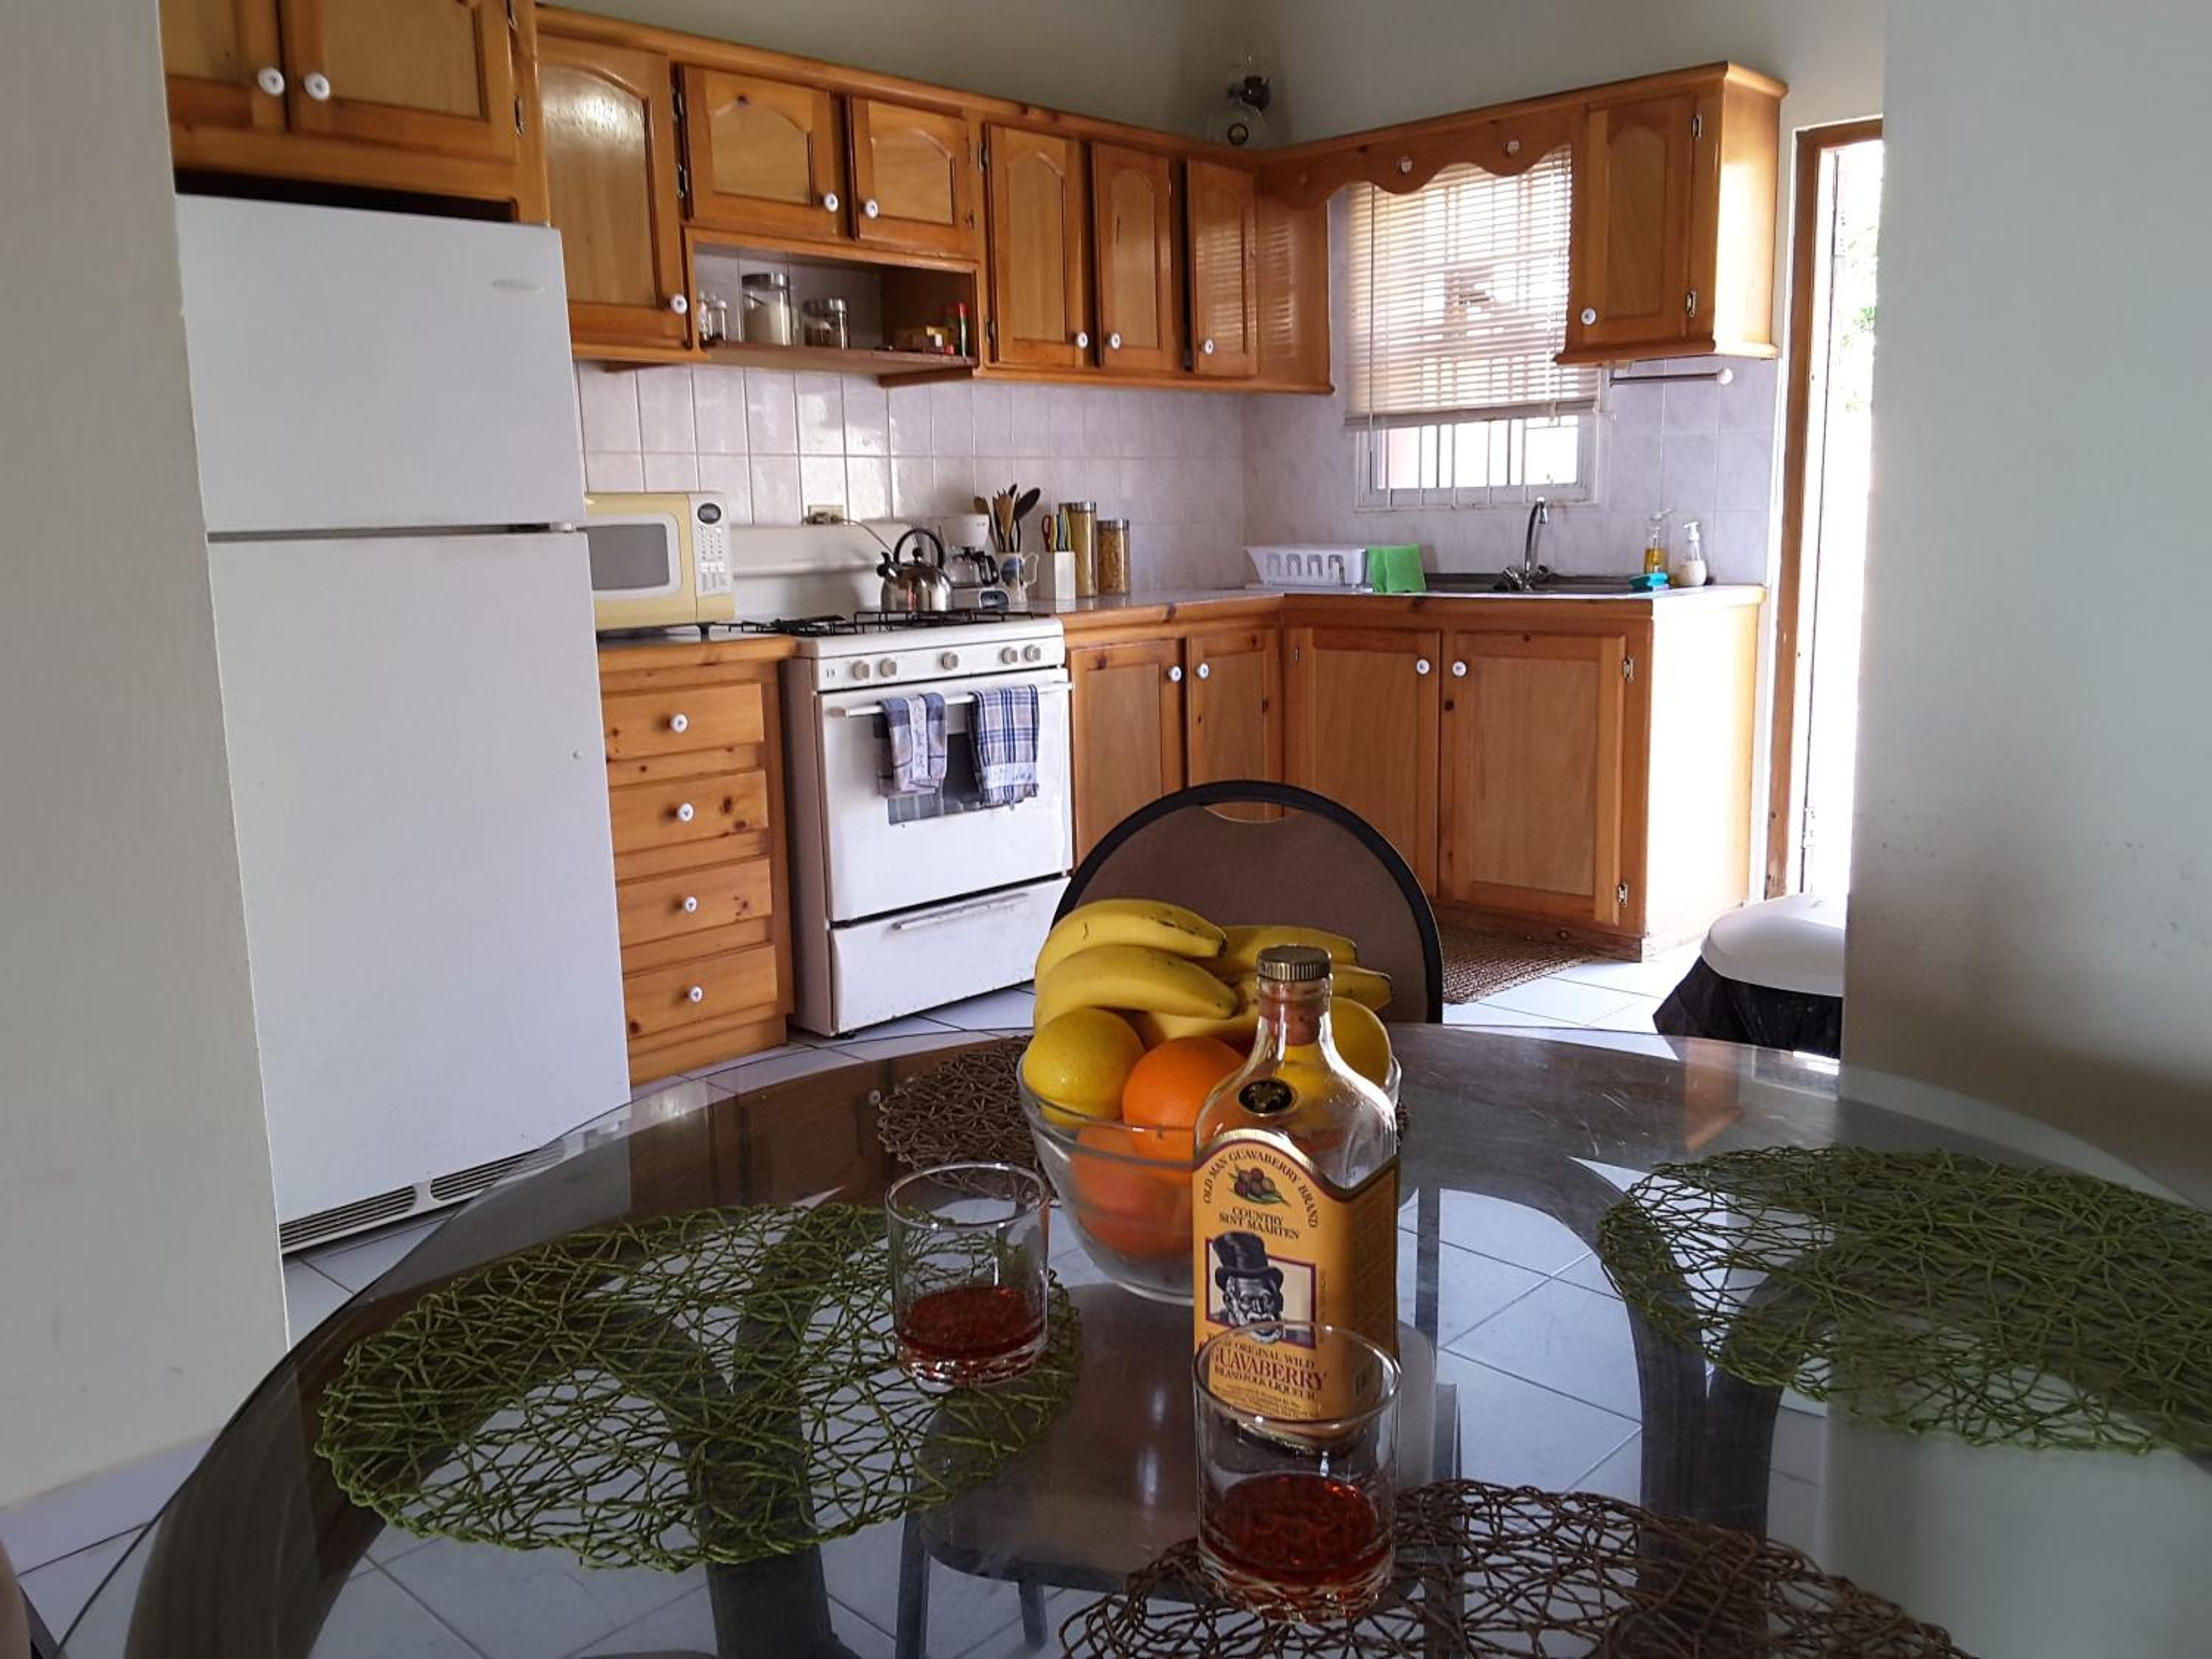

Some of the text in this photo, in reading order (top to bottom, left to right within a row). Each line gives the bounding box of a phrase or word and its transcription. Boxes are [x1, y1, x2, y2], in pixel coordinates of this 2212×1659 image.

[1203, 1179, 1214, 1204] OLD
[1228, 1149, 1298, 1183] GUAVABERRY
[1298, 1183, 1319, 1228] BRAND
[1219, 1211, 1299, 1239] SINT MAARTEN
[1232, 1206, 1284, 1227] COUNTRY
[1211, 1346, 1324, 1391] GUAVABERRY
